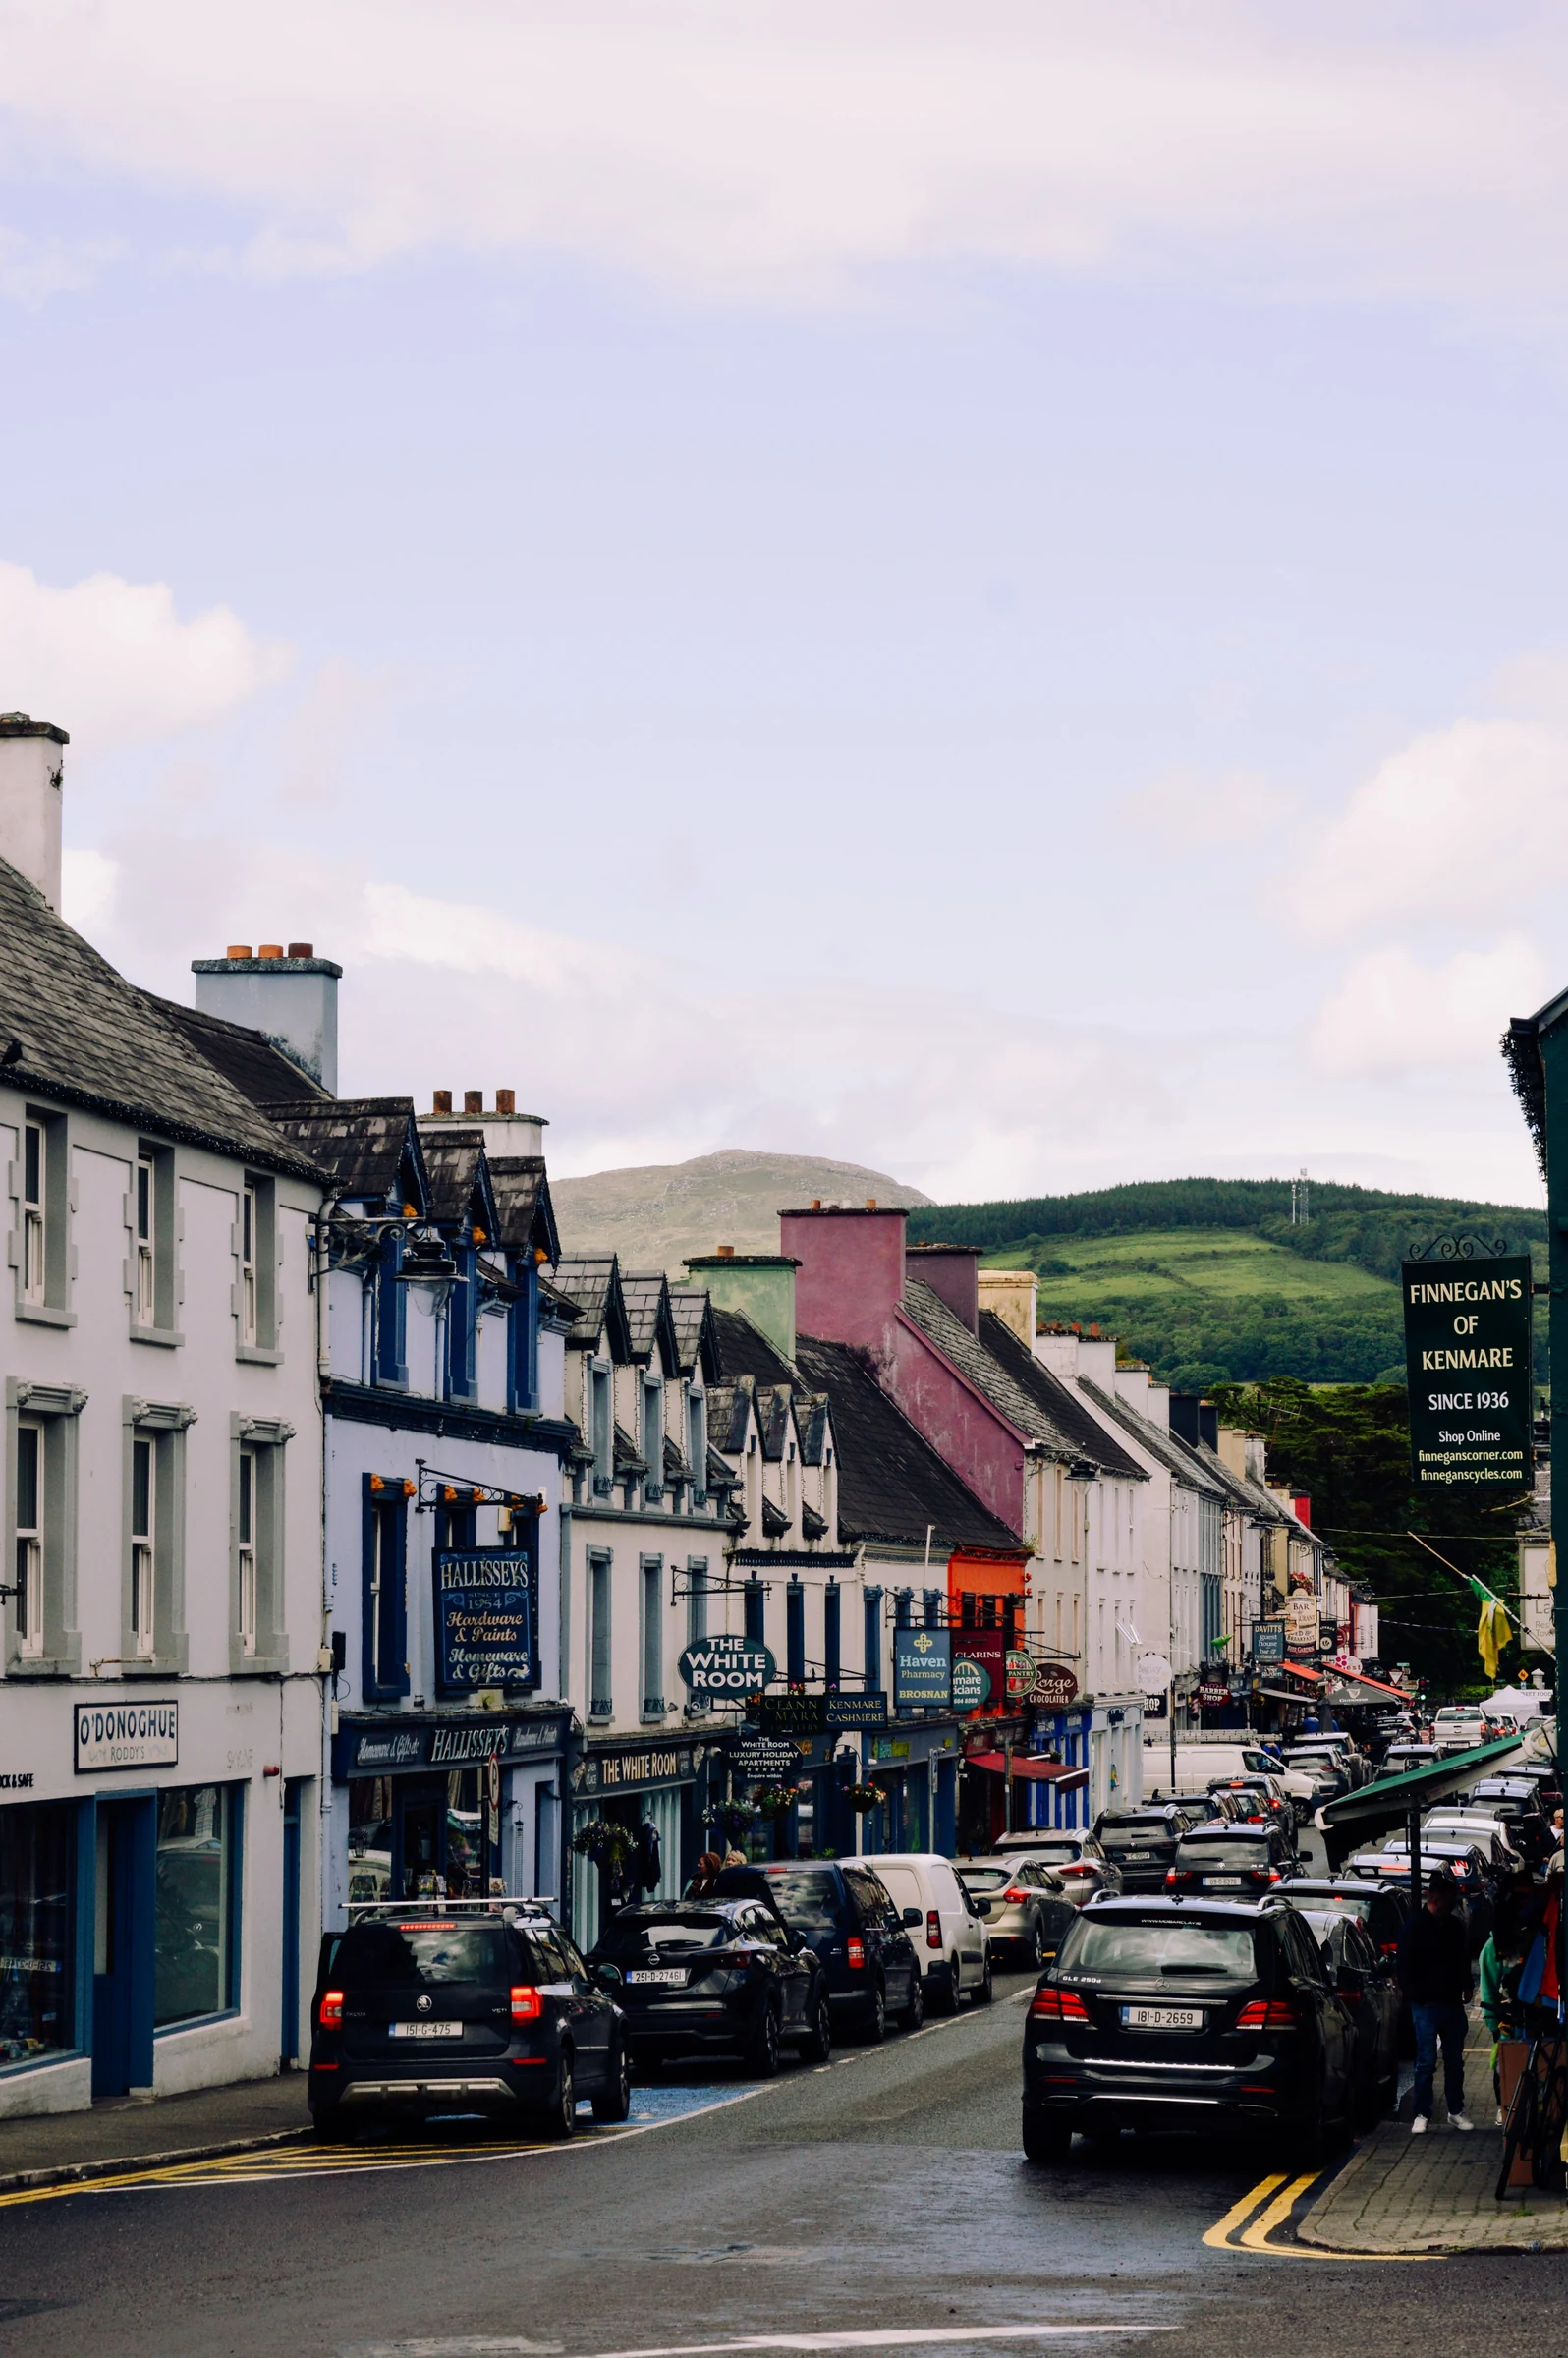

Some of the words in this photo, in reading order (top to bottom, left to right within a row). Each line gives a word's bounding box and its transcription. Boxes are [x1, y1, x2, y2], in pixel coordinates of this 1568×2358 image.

[1410, 1279, 1522, 1303] FINNEGAN'S
[1453, 1316, 1478, 1335] OF
[1422, 1348, 1513, 1370] KENMARE
[1428, 1393, 1473, 1410] SINCE
[1477, 1391, 1509, 1409] 1936
[1438, 1431, 1465, 1445] Shop
[1467, 1430, 1501, 1442] Online
[1419, 1449, 1523, 1465] finneganscorner.com
[1421, 1468, 1522, 1484] finneganscycles.com
[440, 1559, 529, 1590] HALLISSEY'S
[468, 1599, 502, 1609] 1954
[1535, 1600, 1550, 1614] La
[447, 1611, 523, 1627] Hardware
[455, 1627, 467, 1642] &
[472, 1627, 518, 1642] Paints
[707, 1638, 744, 1651] THE
[449, 1648, 529, 1662] Homeware
[686, 1652, 766, 1669] WHITE
[900, 1655, 946, 1667] Haven
[453, 1664, 465, 1679] &
[468, 1662, 506, 1683] Gifts
[693, 1670, 763, 1688] ROOM
[901, 1669, 946, 1680] Pharmacy
[899, 1690, 948, 1699] BROSNAN
[953, 1685, 981, 1695] icians
[1199, 1686, 1228, 1695] BARBER
[764, 1699, 817, 1710] CEANN
[829, 1700, 882, 1710] KENMARE
[1029, 1693, 1069, 1703] CHOCOLATIER
[1144, 1698, 1160, 1711] HOP
[775, 1712, 818, 1721] MARA
[826, 1713, 884, 1722] CASHMERE
[81, 1709, 175, 1745] O'DONOGHUE
[430, 1724, 510, 1762] HALLISSEY'S
[110, 1746, 144, 1763] RODDY'S
[602, 1759, 620, 1784] THE
[622, 1755, 650, 1781] WHITE
[651, 1752, 677, 1777] ROOM
[18, 1773, 34, 1788] SAFE
[636, 1971, 682, 1982] 251-D-27461
[1137, 2011, 1194, 2025] 181-D-2659
[406, 2024, 451, 2036] 151-G-475
